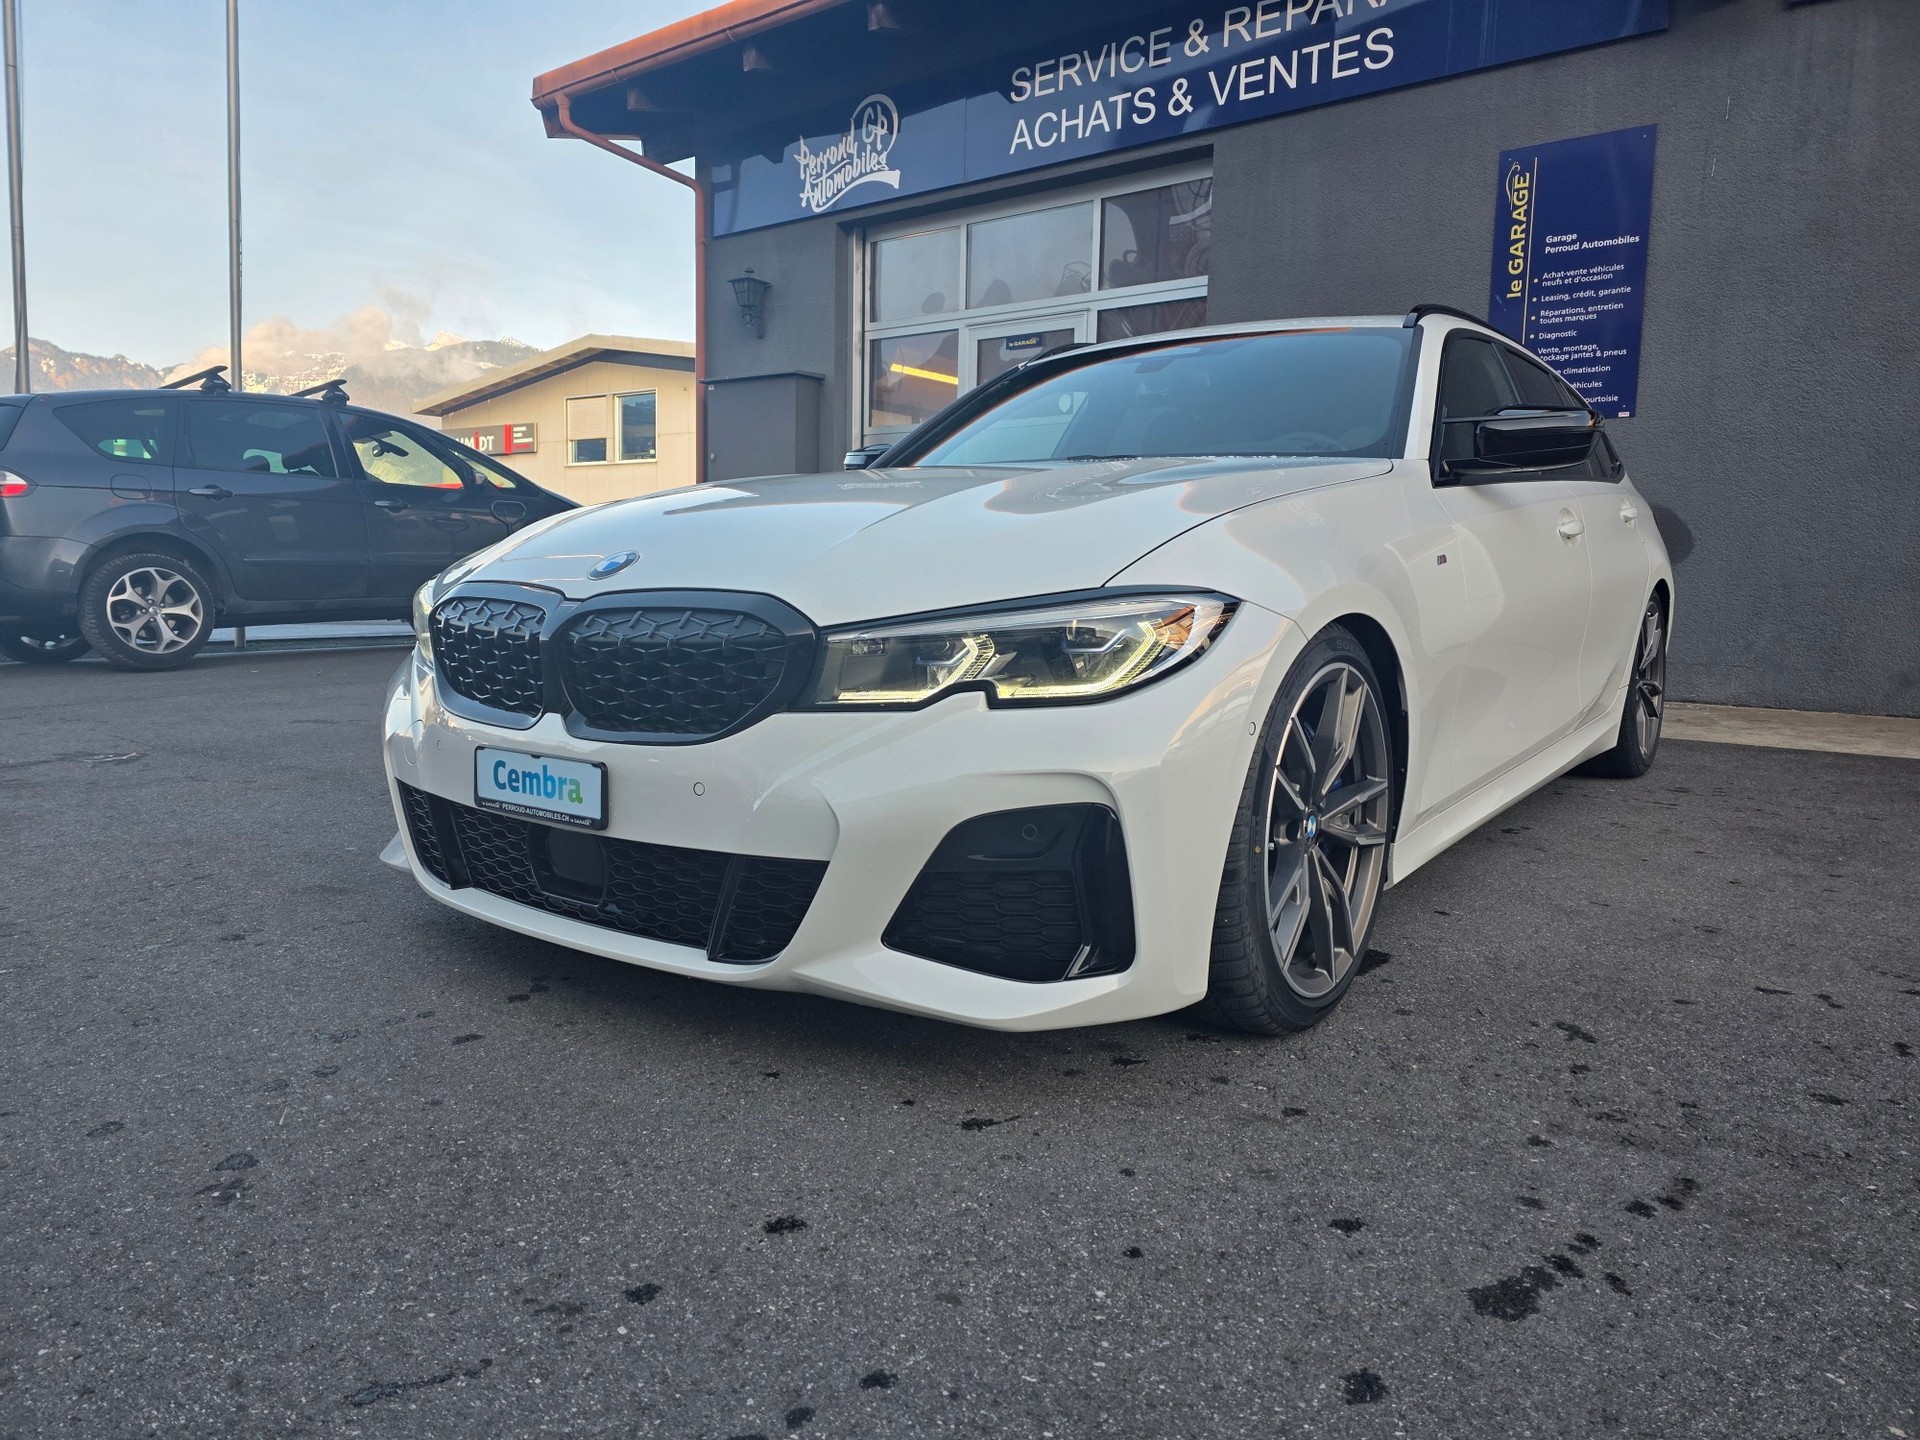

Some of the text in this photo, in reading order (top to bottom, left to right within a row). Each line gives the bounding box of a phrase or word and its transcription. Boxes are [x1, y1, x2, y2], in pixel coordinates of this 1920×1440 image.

[1010, 0, 1388, 102] SERVICE & REPA
[1009, 27, 1395, 155] ACHATS & VENTES
[799, 142, 890, 209] Automobiles
[1506, 172, 1530, 298] le GARAGE
[1546, 233, 1577, 244] Garage
[1545, 235, 1640, 254] Perroud Automobiles
[1542, 263, 1625, 279] Achat-vente véhicules
[1542, 278, 1562, 287] neufs
[1541, 293, 1571, 302] Leasing,
[1598, 286, 1632, 297] garantie
[1540, 302, 1624, 318] Réparations, entretien
[1540, 313, 1597, 325] toutes marques
[1538, 330, 1578, 340] Diagnostic
[1014, 338, 1038, 347] GARAGE
[1537, 344, 1599, 354] Vente, montage,
[1570, 351, 1594, 360] jantes
[1603, 349, 1627, 358] pneus
[1563, 365, 1611, 375] climatisation
[1571, 381, 1603, 389] éhicules
[1585, 395, 1619, 403] ourtoisie
[492, 759, 584, 805] Cembra
[501, 803, 570, 822] PERROUD-AUTOMOBILES.CH
